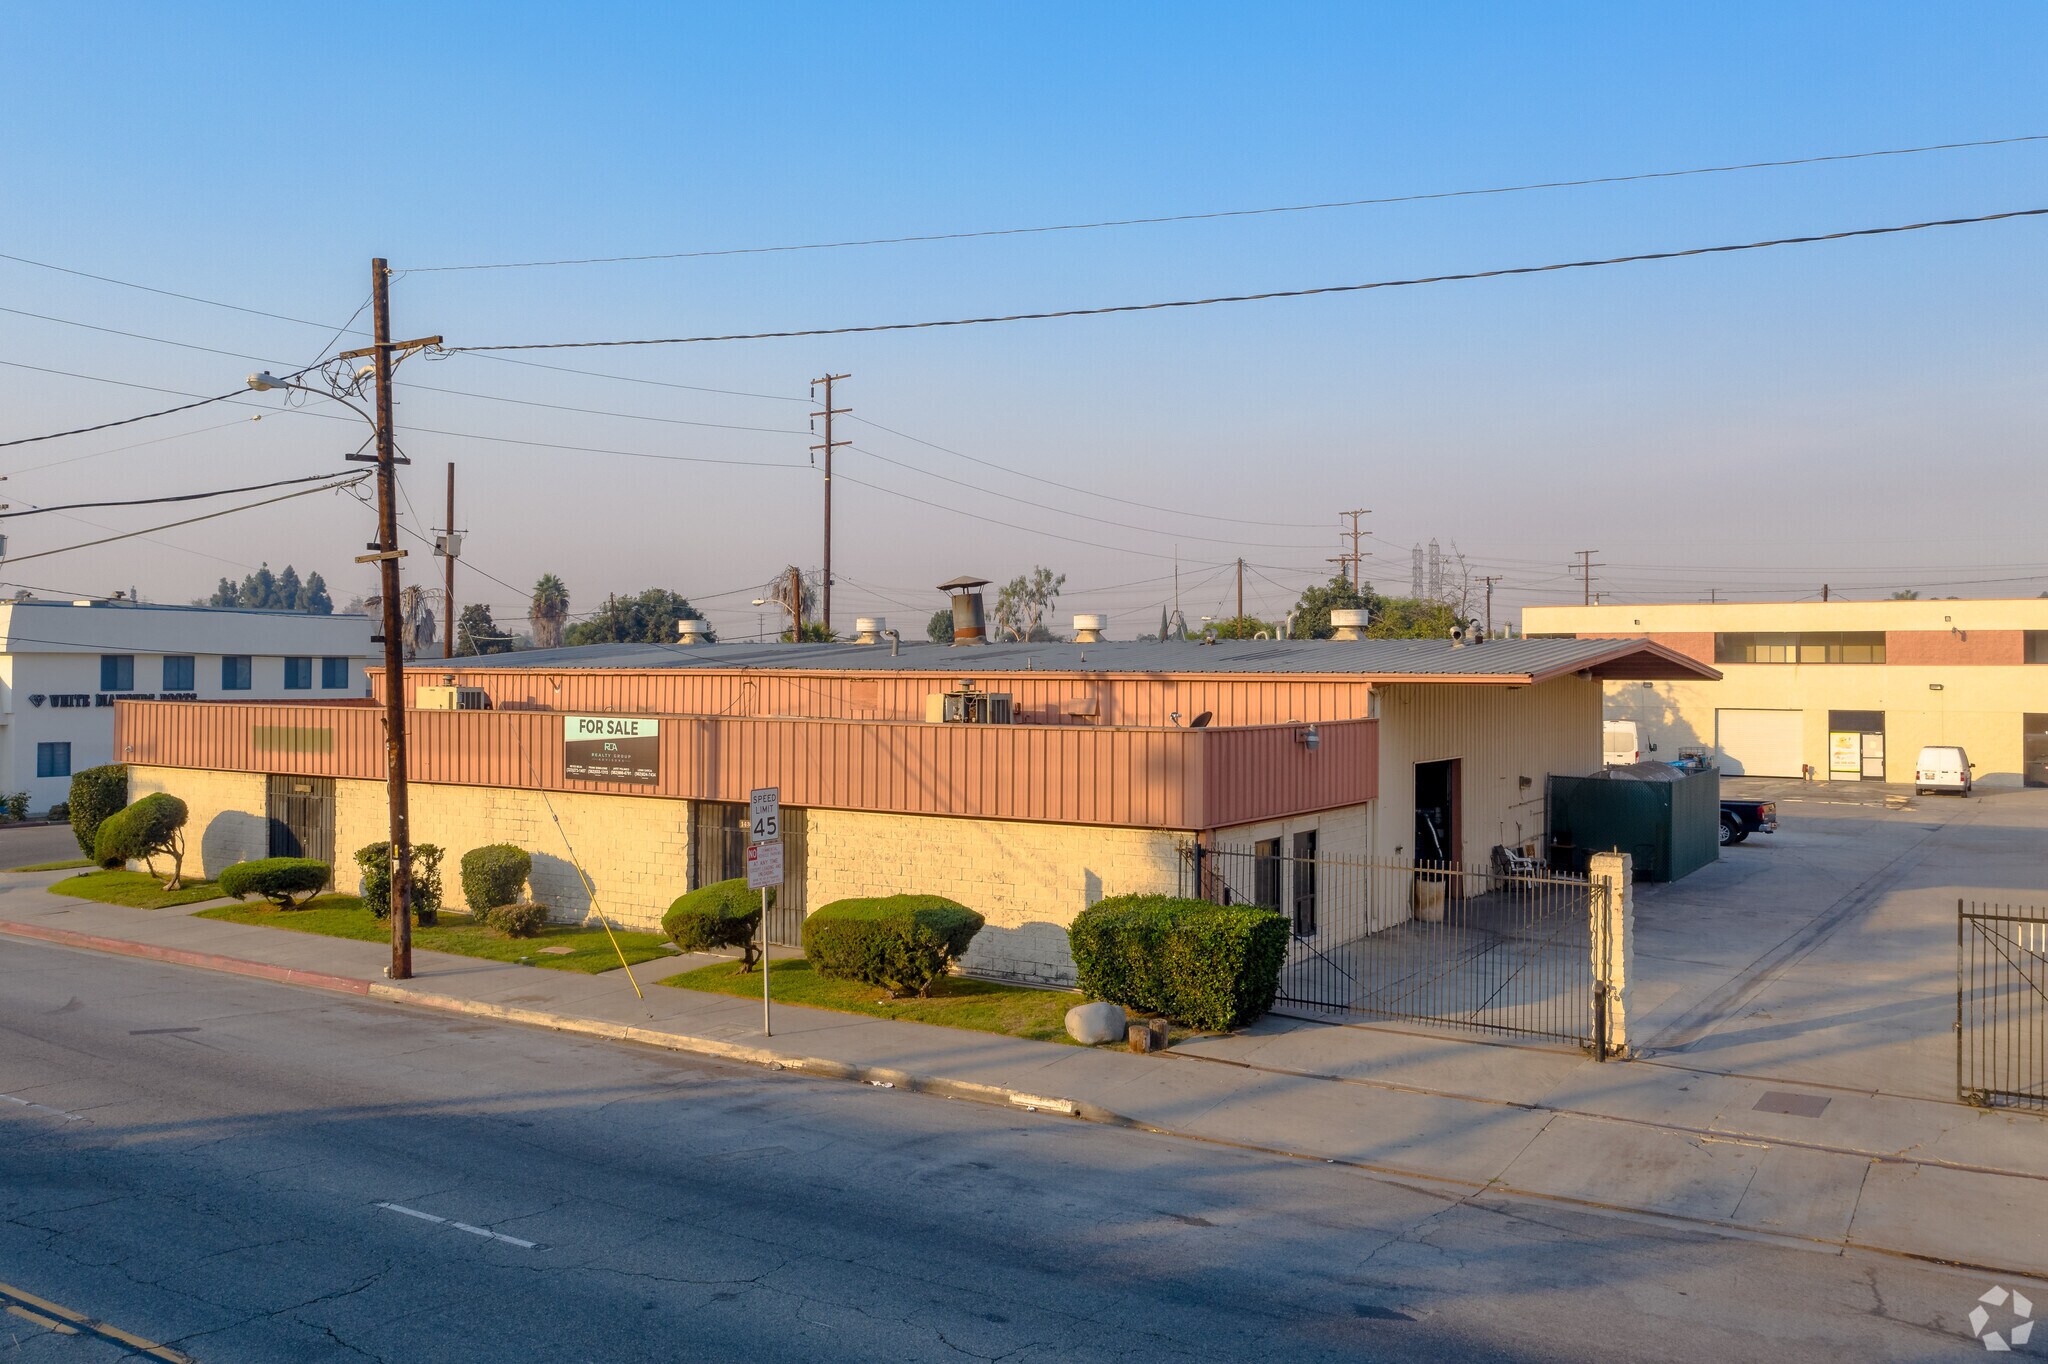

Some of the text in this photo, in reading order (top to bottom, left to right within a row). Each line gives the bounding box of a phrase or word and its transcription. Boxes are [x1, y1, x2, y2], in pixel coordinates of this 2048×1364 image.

[49, 694, 90, 707] WHITE
[579, 719, 639, 736] FOR SALE
[753, 793, 777, 804] SPEED
[755, 804, 774, 815] LIMIT
[753, 816, 777, 837] 45
[748, 848, 757, 859] NO
